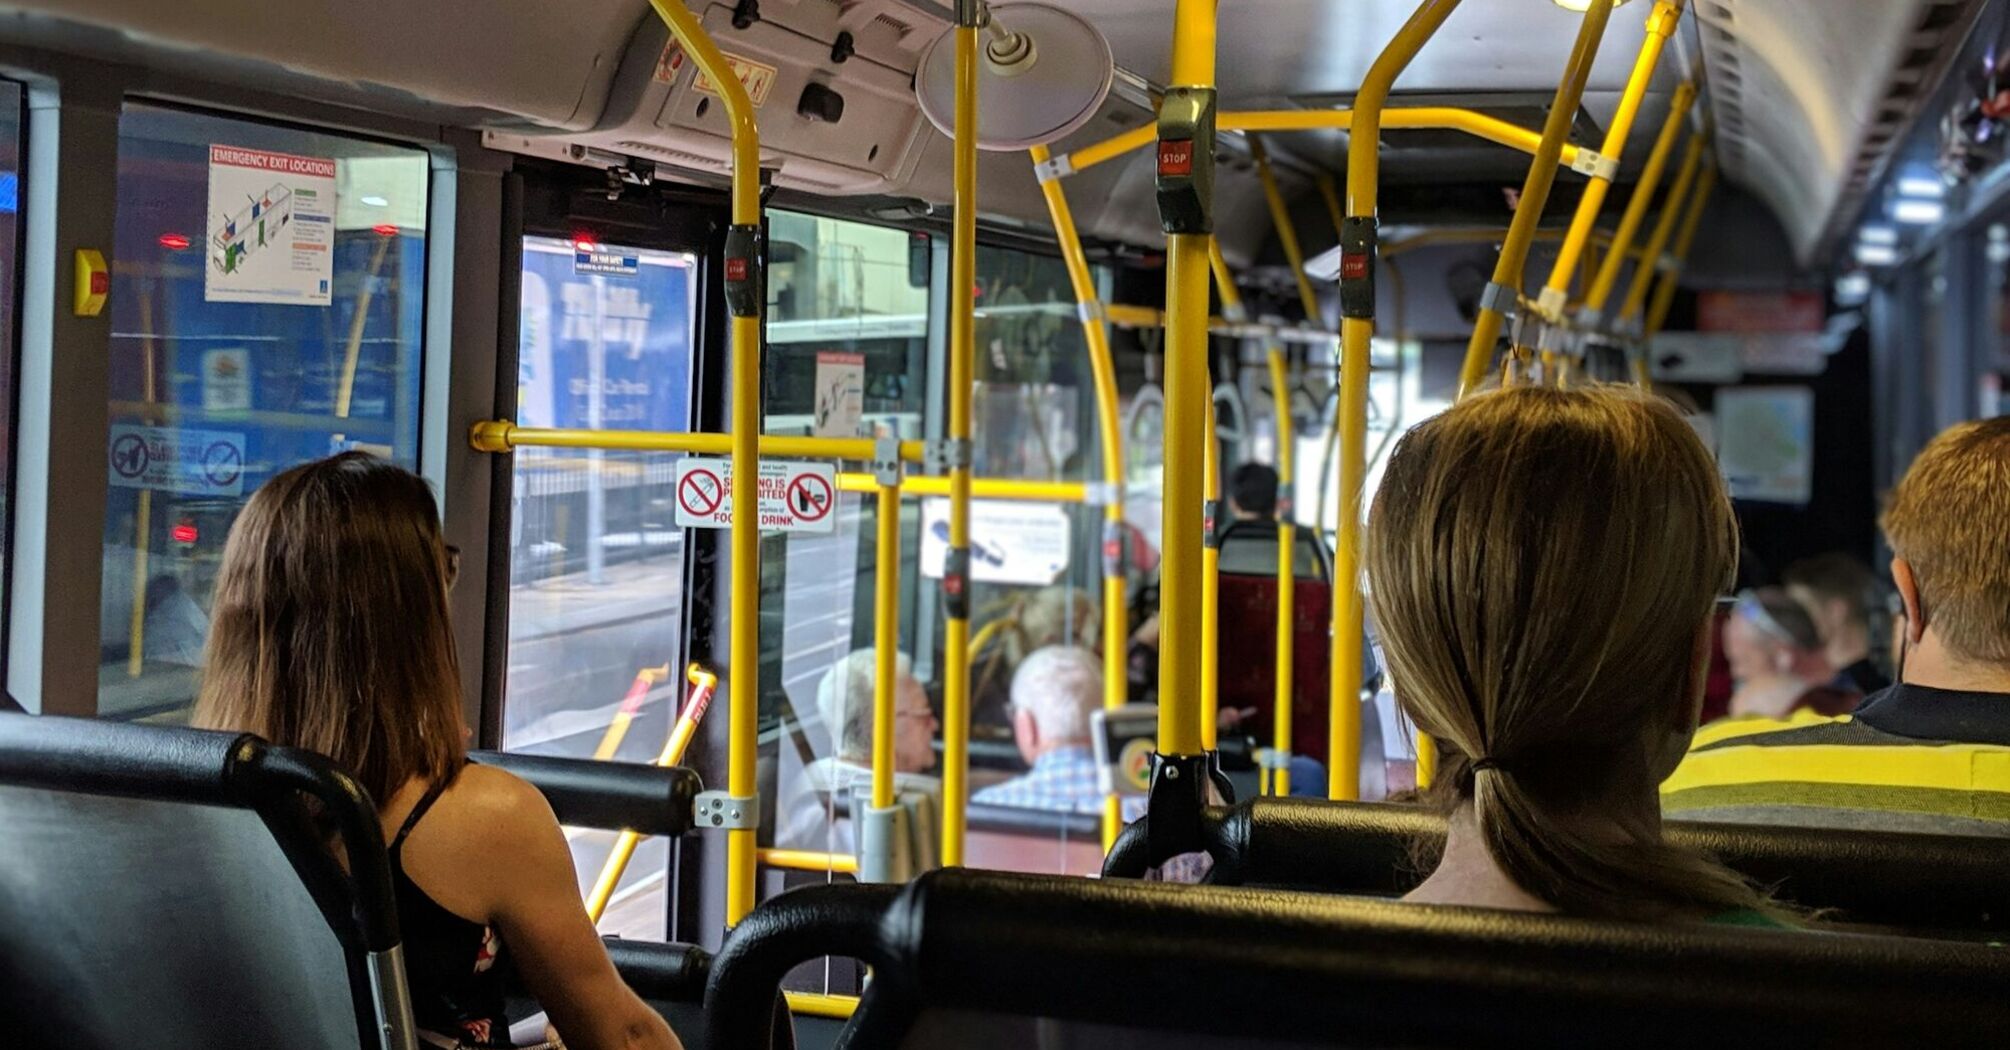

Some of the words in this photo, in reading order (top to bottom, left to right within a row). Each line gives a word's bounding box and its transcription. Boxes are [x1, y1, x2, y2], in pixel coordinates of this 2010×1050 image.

[213, 149, 268, 167] EMERGENCY
[269, 158, 288, 169] EXIT
[289, 160, 335, 176] LOCATIONS
[1162, 152, 1187, 164] STOP
[1344, 261, 1364, 272] STOP
[775, 479, 785, 488] IS
[761, 514, 794, 526] DRINK
